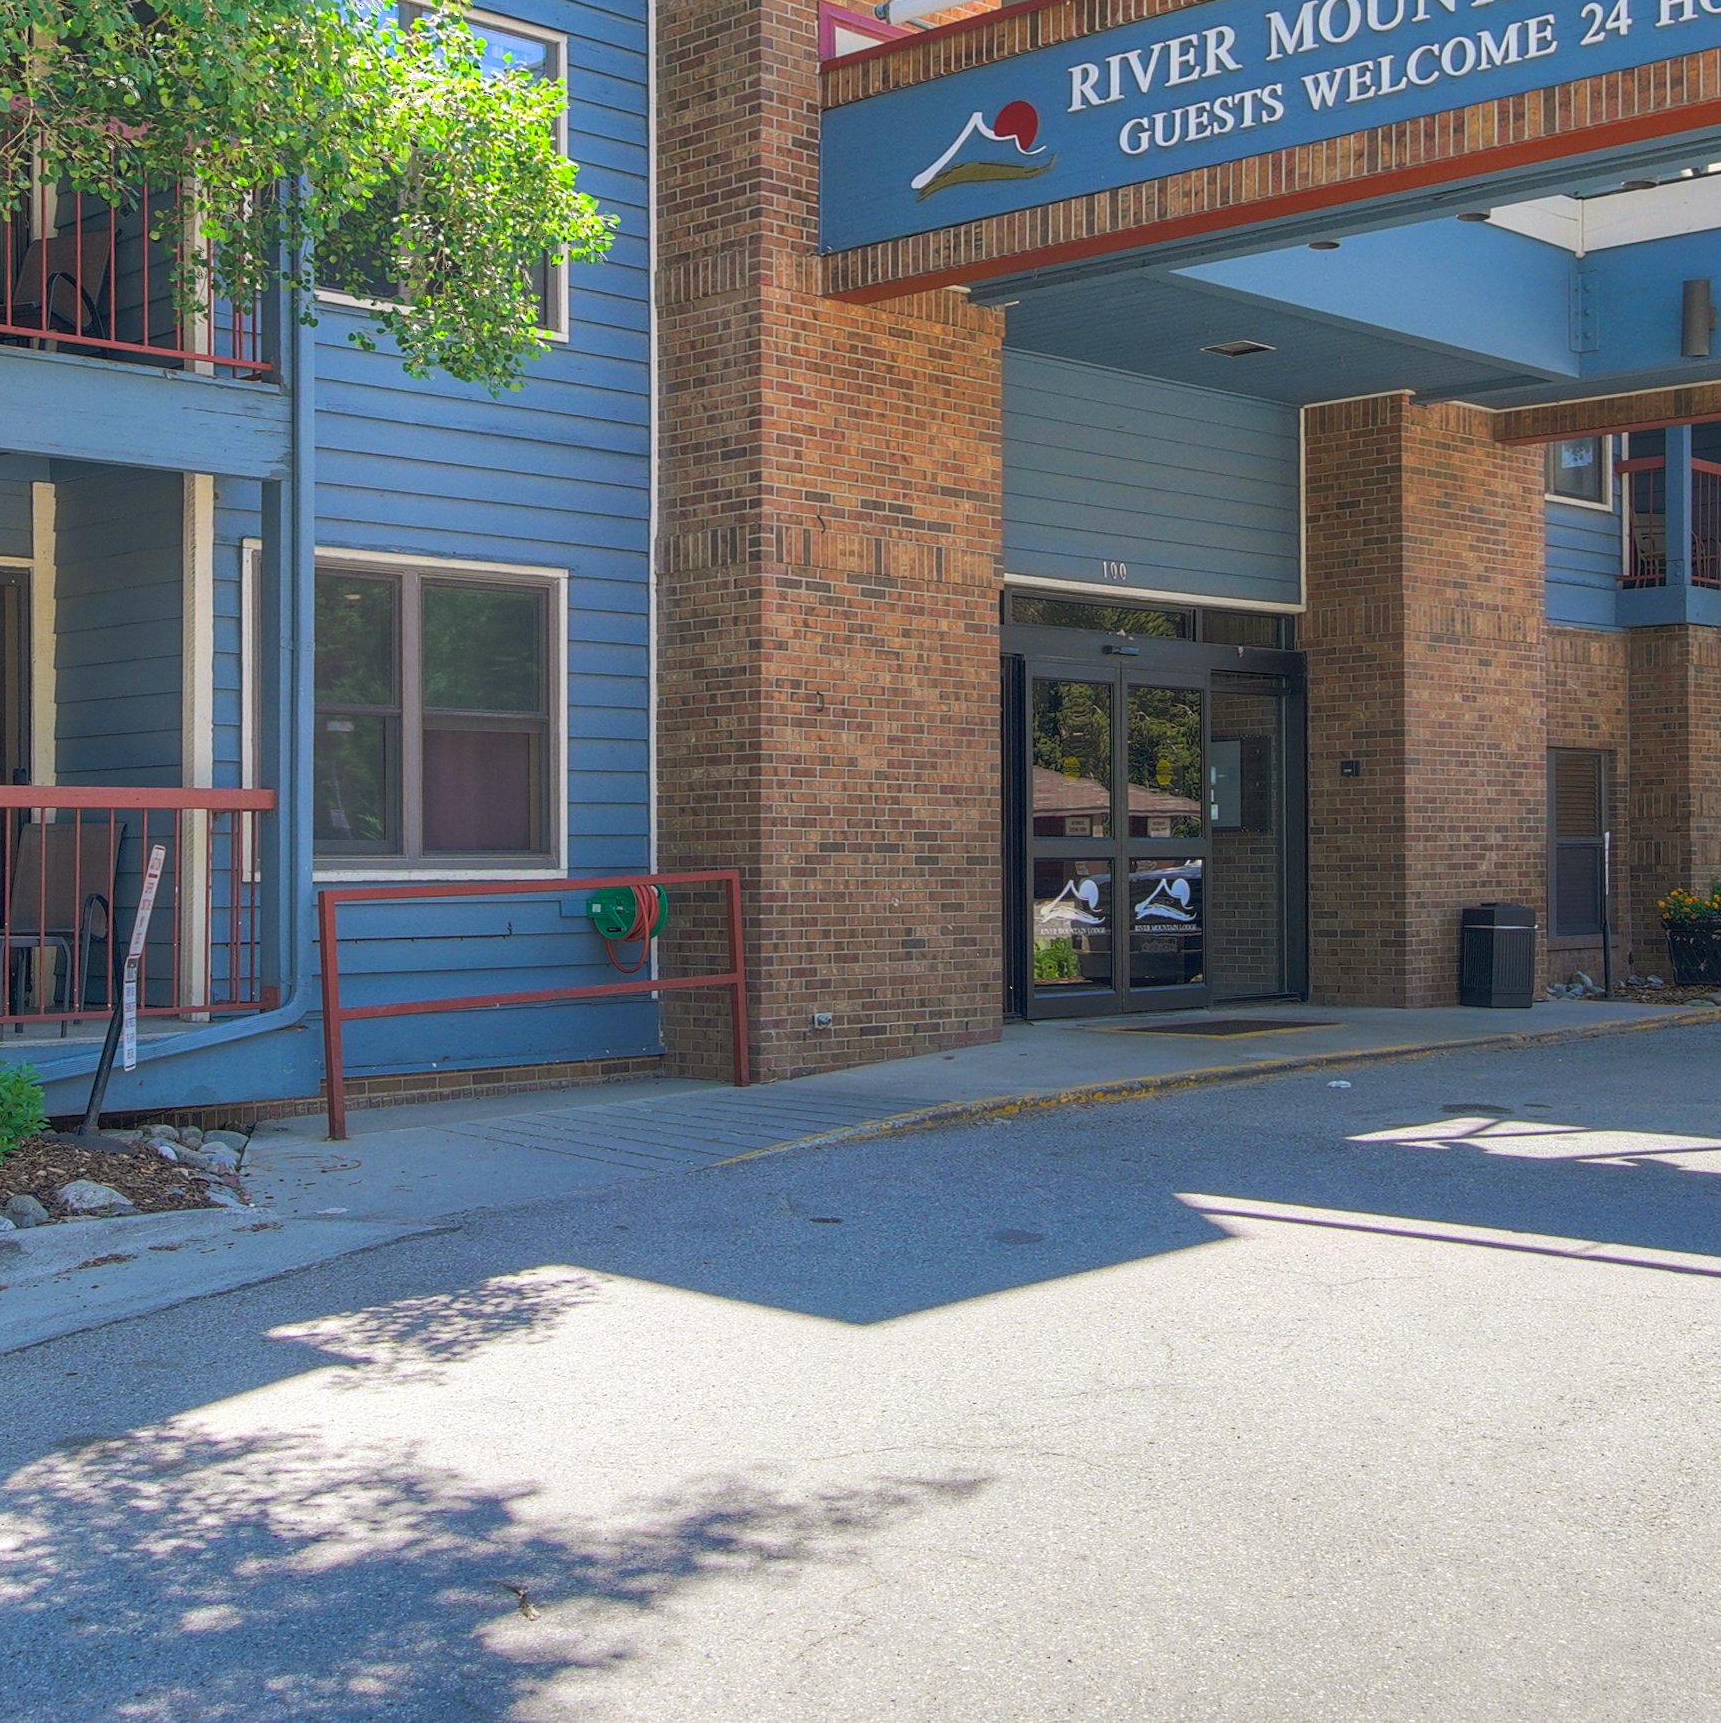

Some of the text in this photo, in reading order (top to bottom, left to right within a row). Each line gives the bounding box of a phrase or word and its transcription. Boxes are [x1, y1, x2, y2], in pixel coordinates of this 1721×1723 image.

[1066, 24, 1244, 114] RIVER
[1118, 82, 1285, 156] GUESTS
[1300, 12, 1559, 112] WELCOME
[1103, 561, 1127, 580] 100
